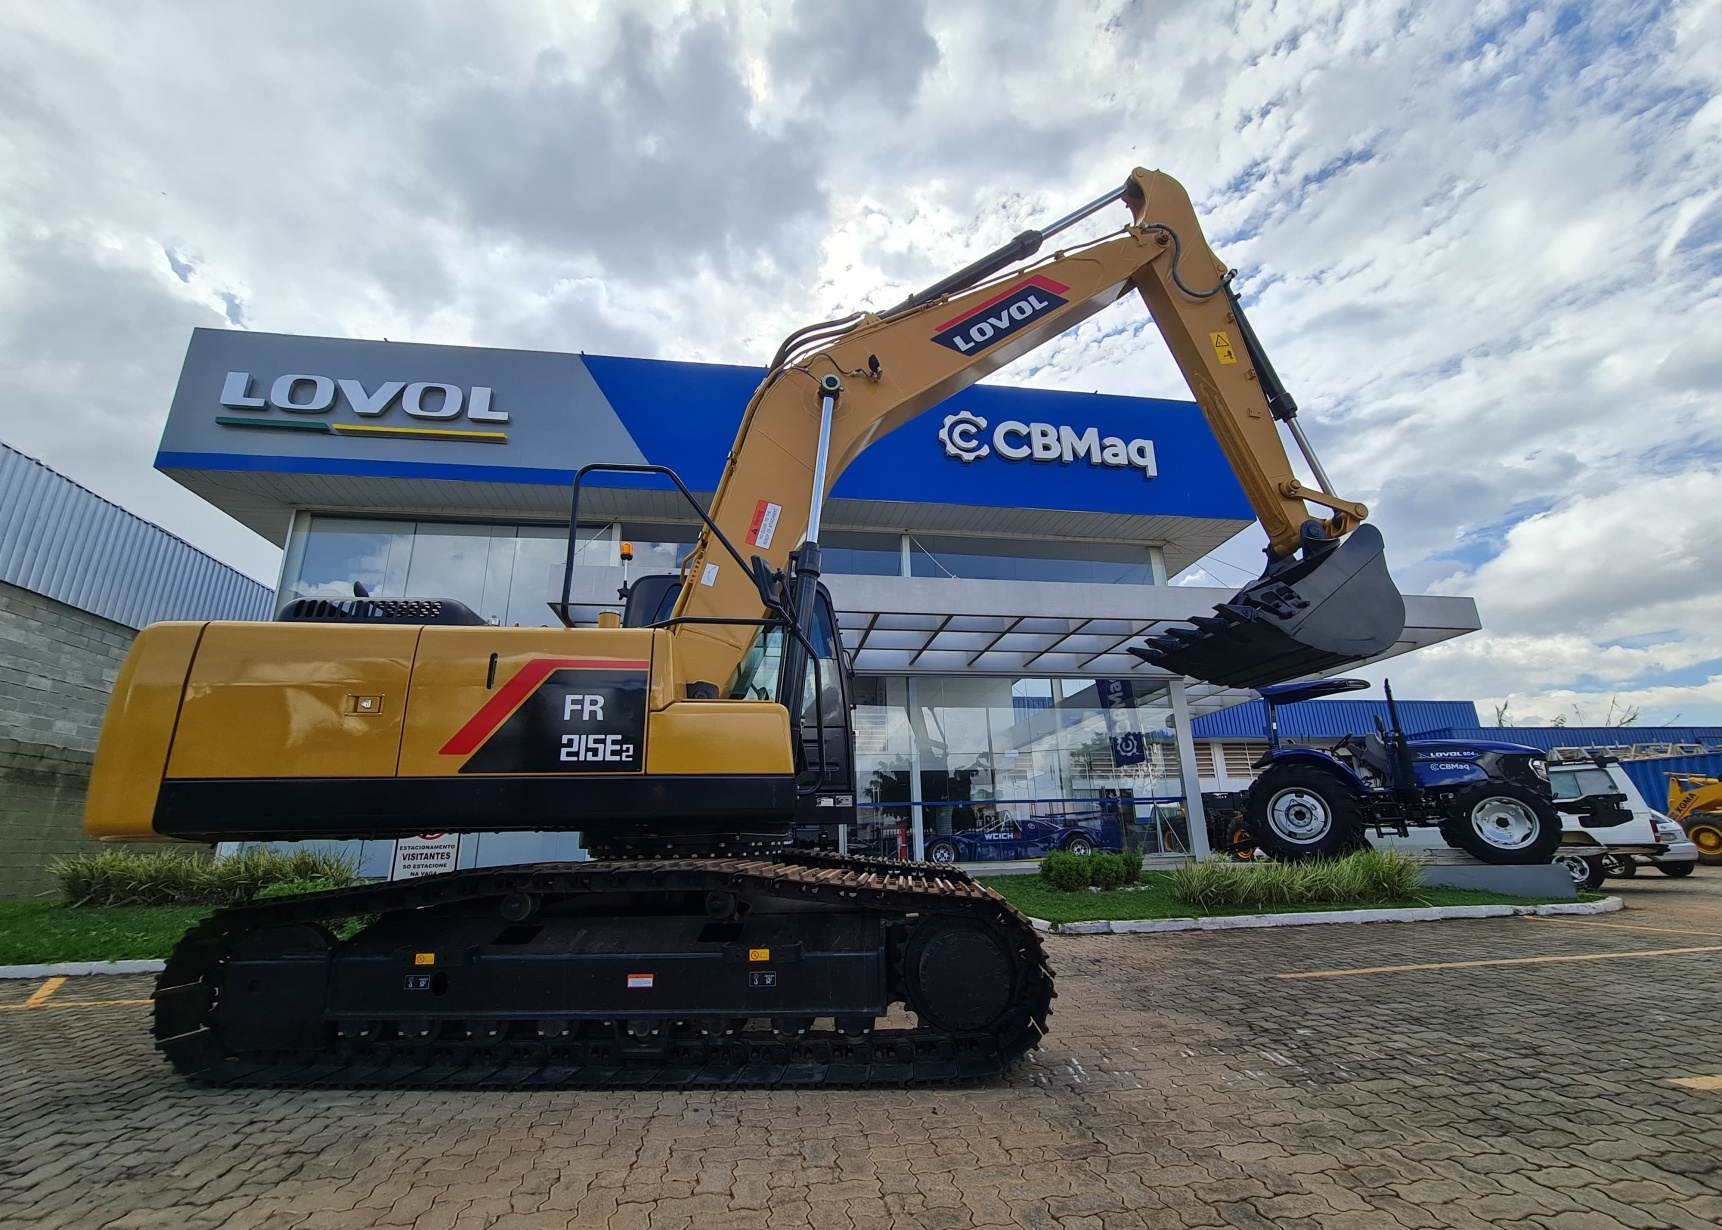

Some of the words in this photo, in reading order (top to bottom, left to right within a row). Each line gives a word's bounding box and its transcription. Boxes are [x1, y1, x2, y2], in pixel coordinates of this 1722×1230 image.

[952, 294, 1049, 352] LOVOL
[219, 371, 512, 422] LOVOL
[992, 420, 1158, 479] CBMaq
[563, 694, 605, 721] FR
[1439, 763, 1470, 771] CBMaq
[1674, 792, 1697, 813] XGMA
[402, 852, 451, 861] VISITANTES
